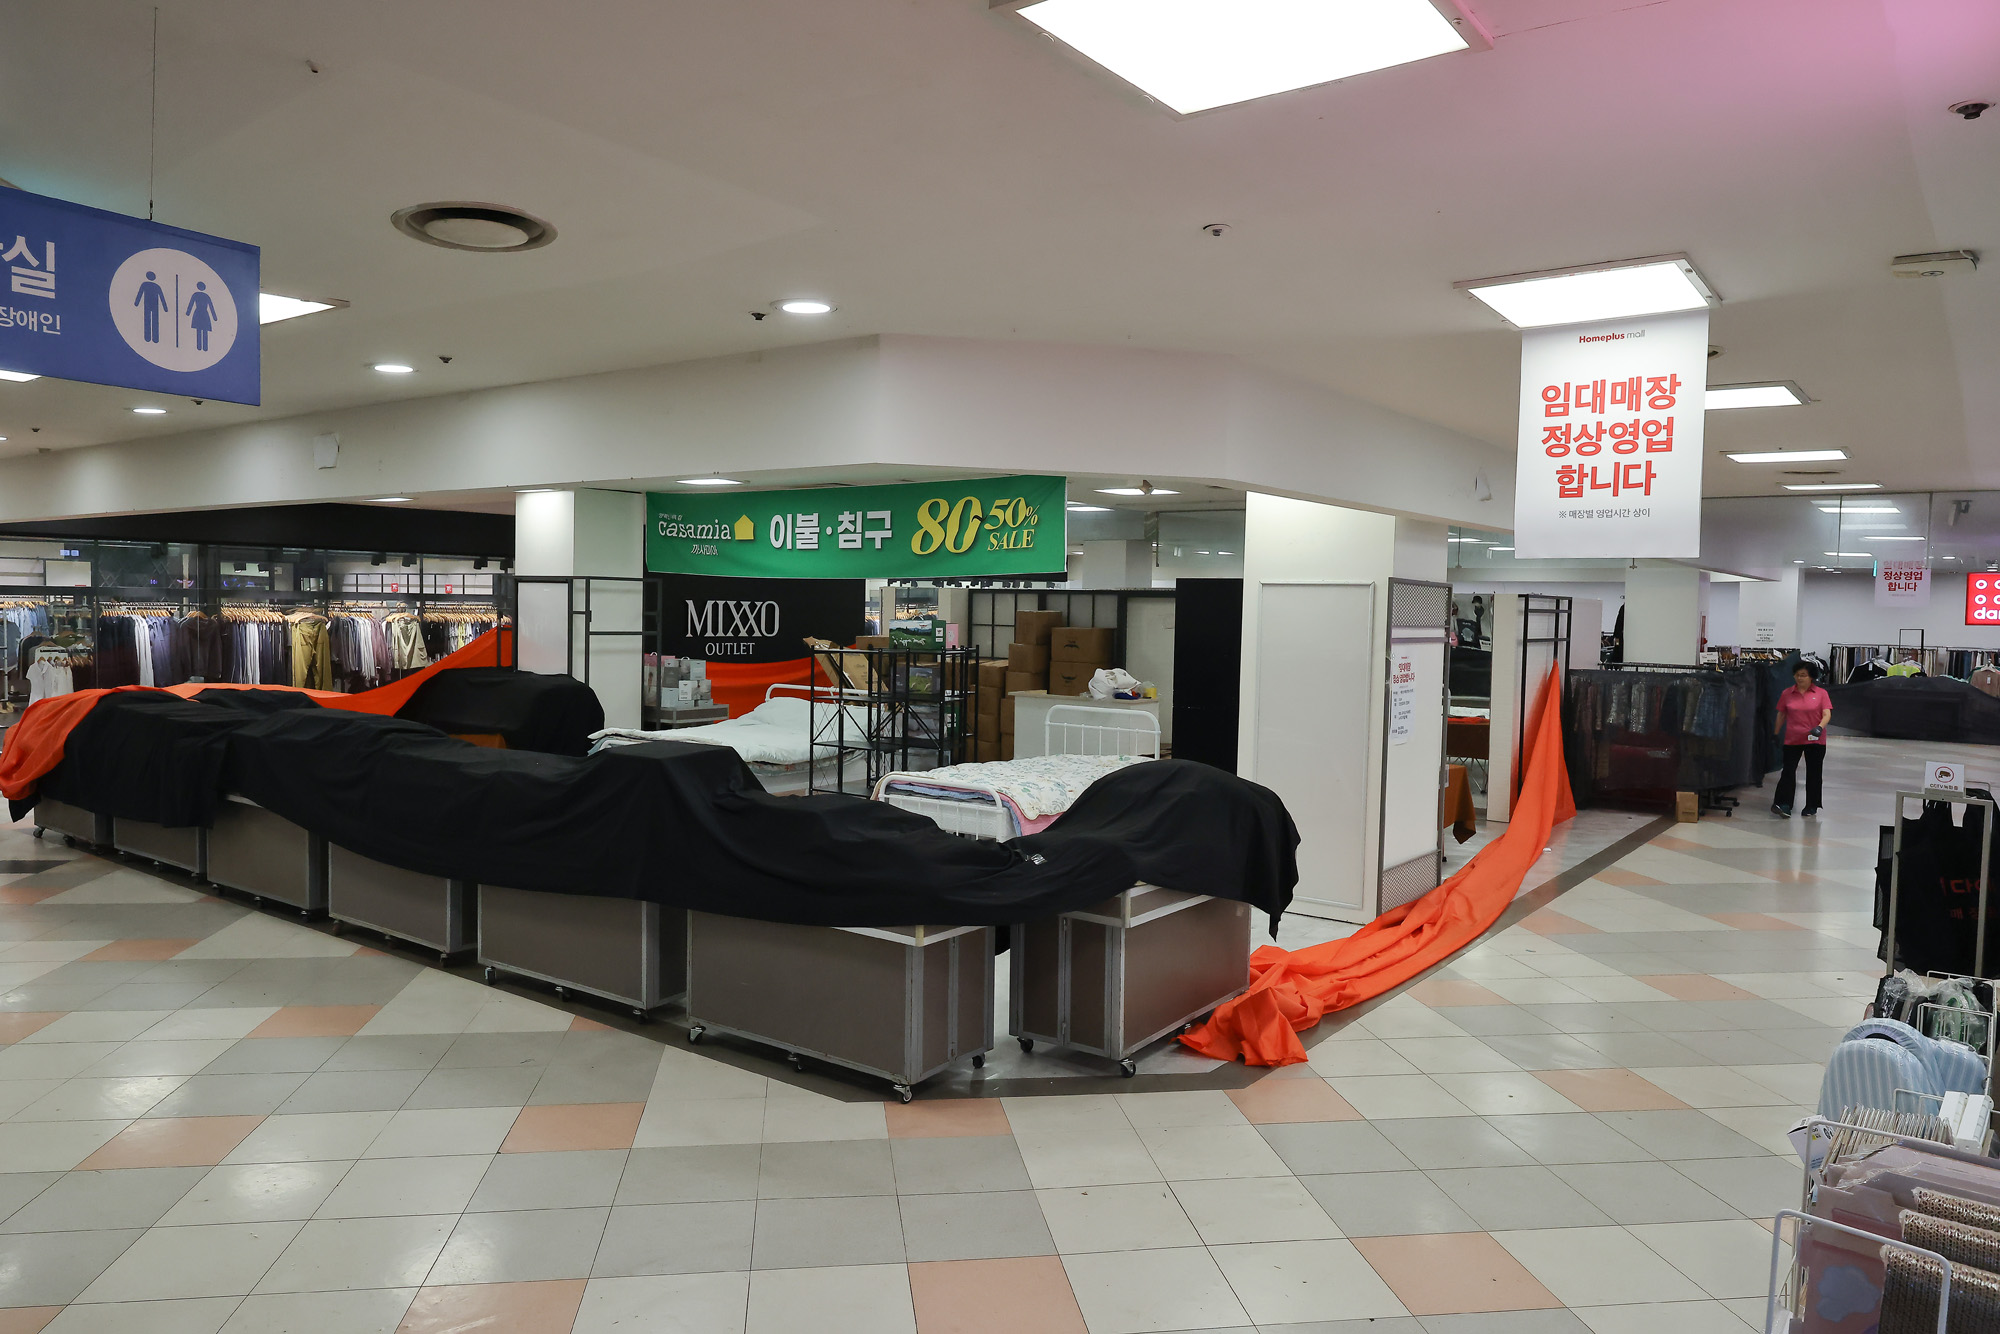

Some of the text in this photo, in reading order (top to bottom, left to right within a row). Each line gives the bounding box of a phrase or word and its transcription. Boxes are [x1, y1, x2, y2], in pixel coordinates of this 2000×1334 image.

[0, 235, 56, 299] 실
[1579, 329, 1646, 343] Homeplus mall
[1541, 373, 1682, 417] 임대매장
[1541, 416, 1675, 457] 정상영업
[1556, 460, 1656, 498] 합니다
[1568, 509, 1594, 519] 매장별
[1596, 508, 1630, 519] 영업시간
[1633, 507, 1650, 518] 상이
[658, 519, 731, 540] casamia
[987, 528, 1035, 551] SALE
[1883, 571, 1923, 581] 정상영업
[1888, 582, 1918, 592] 합니다
[685, 600, 780, 637] MIXXO
[1974, 606, 2000, 620] da
[705, 642, 755, 656] OUTLET
